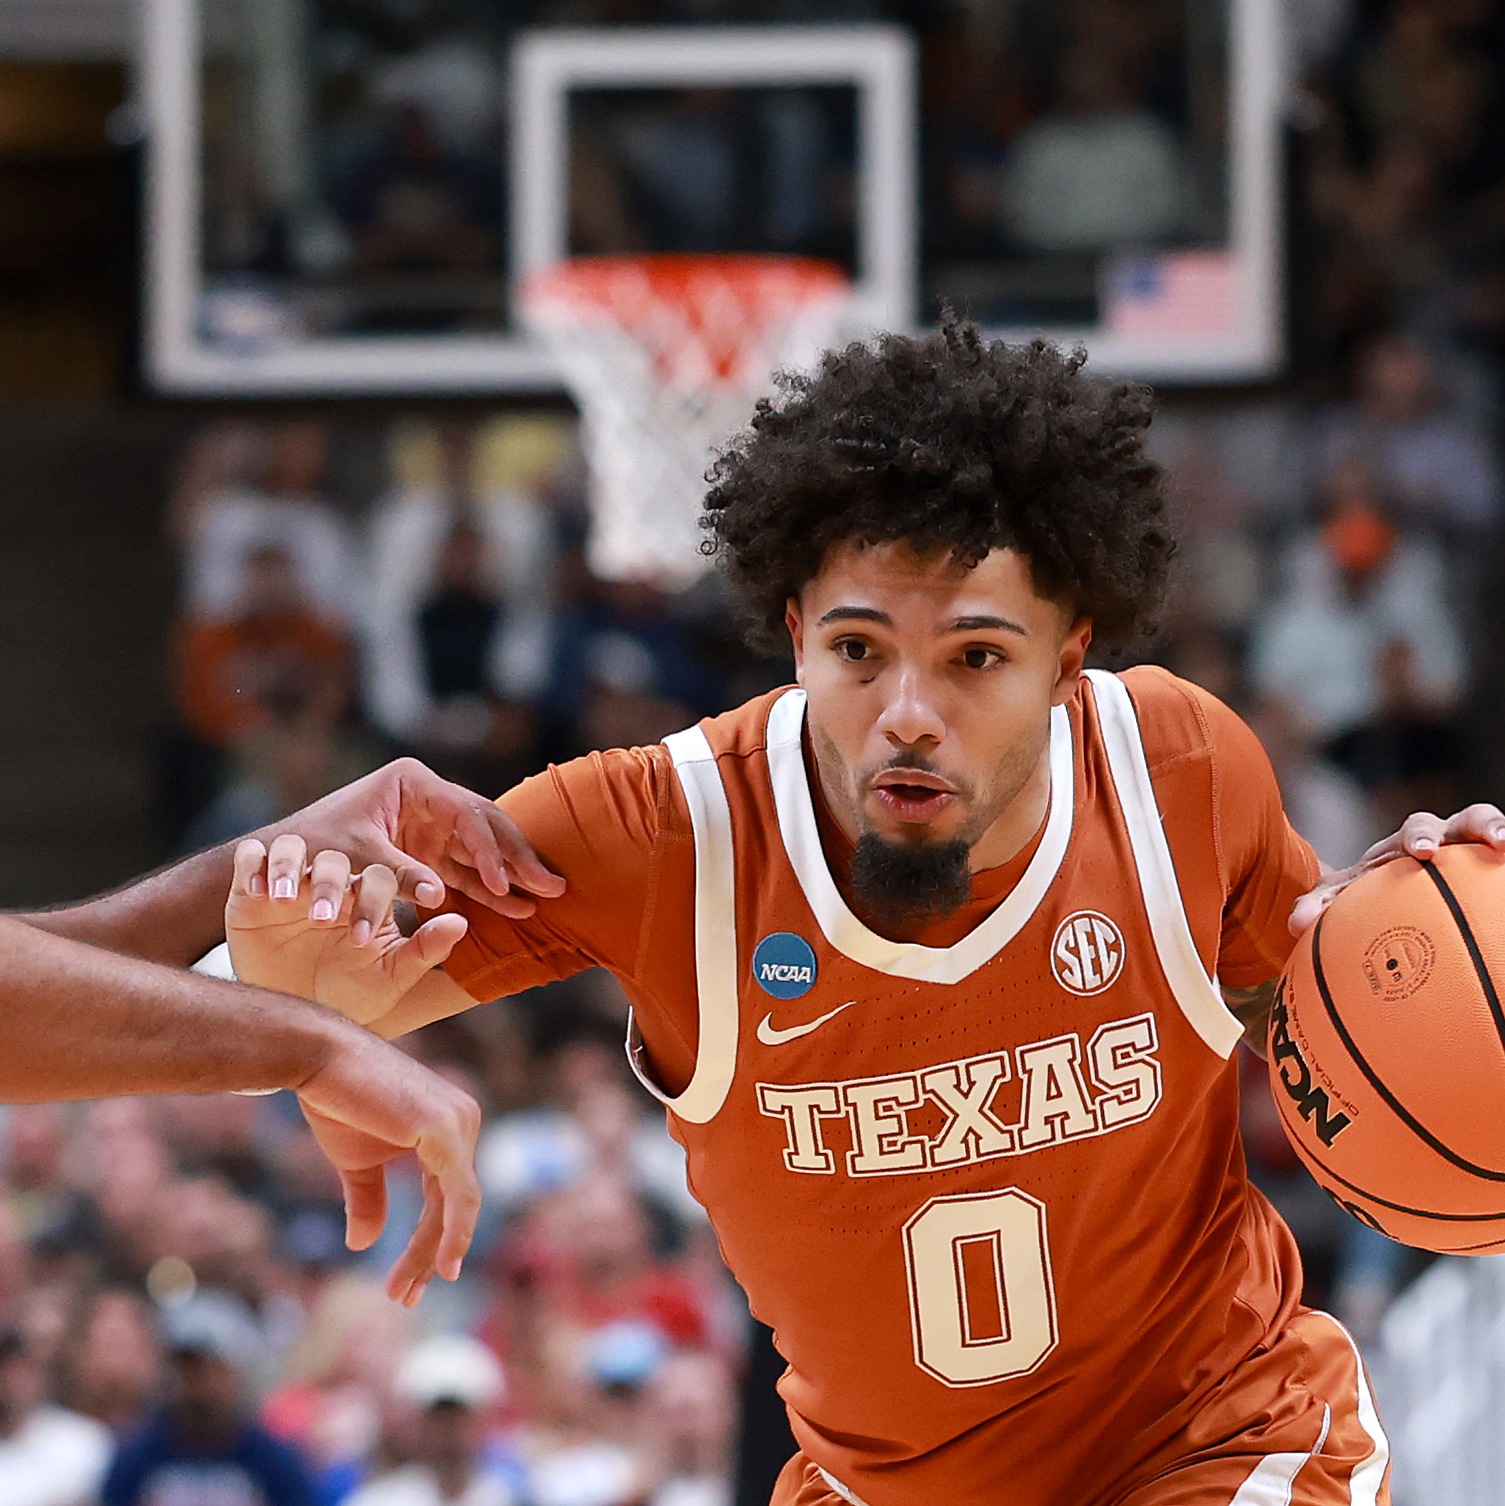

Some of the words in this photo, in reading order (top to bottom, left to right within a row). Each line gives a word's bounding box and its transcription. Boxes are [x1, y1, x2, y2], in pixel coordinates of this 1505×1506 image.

[759, 962, 813, 984] NCAA
[1055, 916, 1119, 991] SEC
[755, 1012, 1163, 1178] TEXAS
[1310, 1051, 1360, 1118] OFFICIAL
[901, 1186, 1059, 1388] 0
